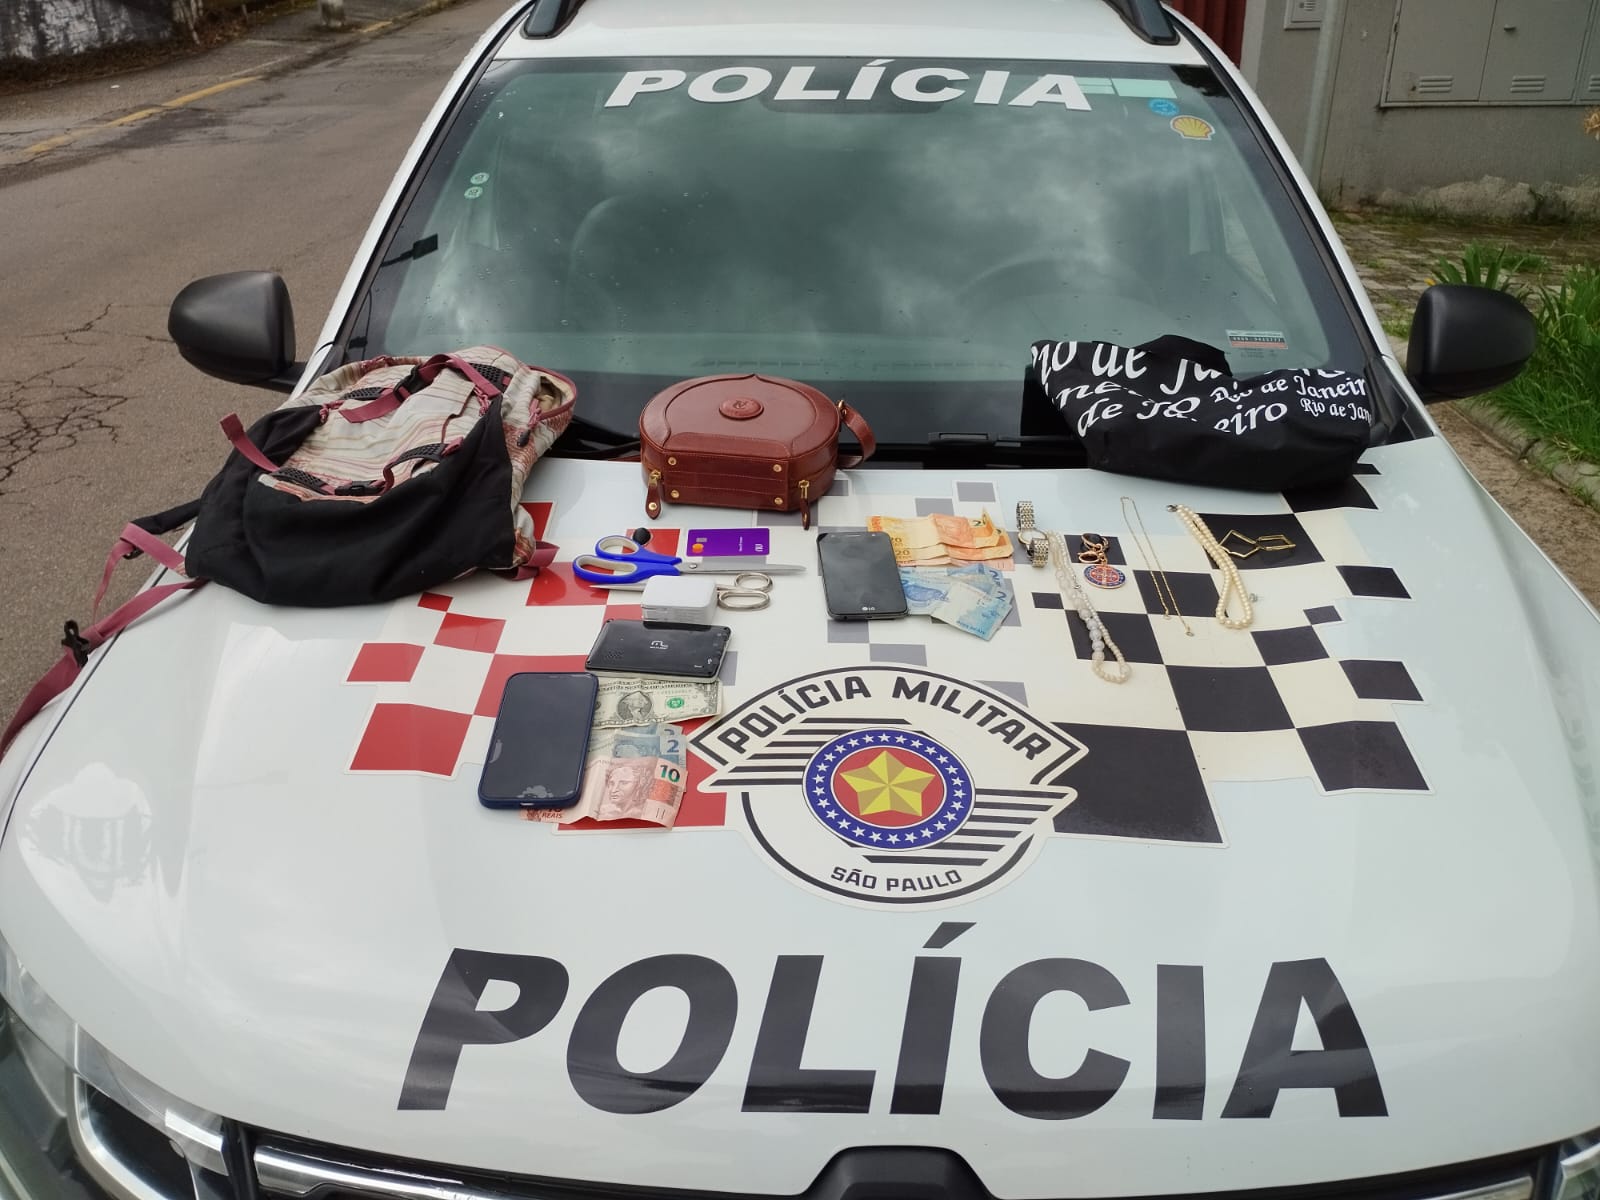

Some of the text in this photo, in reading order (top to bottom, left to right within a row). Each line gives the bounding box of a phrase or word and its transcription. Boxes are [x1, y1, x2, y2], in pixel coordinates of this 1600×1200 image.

[604, 59, 1092, 111] POLÍCIA
[1300, 398, 1325, 417] Rio
[1330, 403, 1346, 417] de
[716, 675, 1052, 760] POLÍCIA MILITAR
[667, 739, 680, 753] 2
[660, 764, 681, 783] 10
[830, 865, 962, 892] SÃO PAULO
[397, 921, 1389, 1120] POLÍCIA
